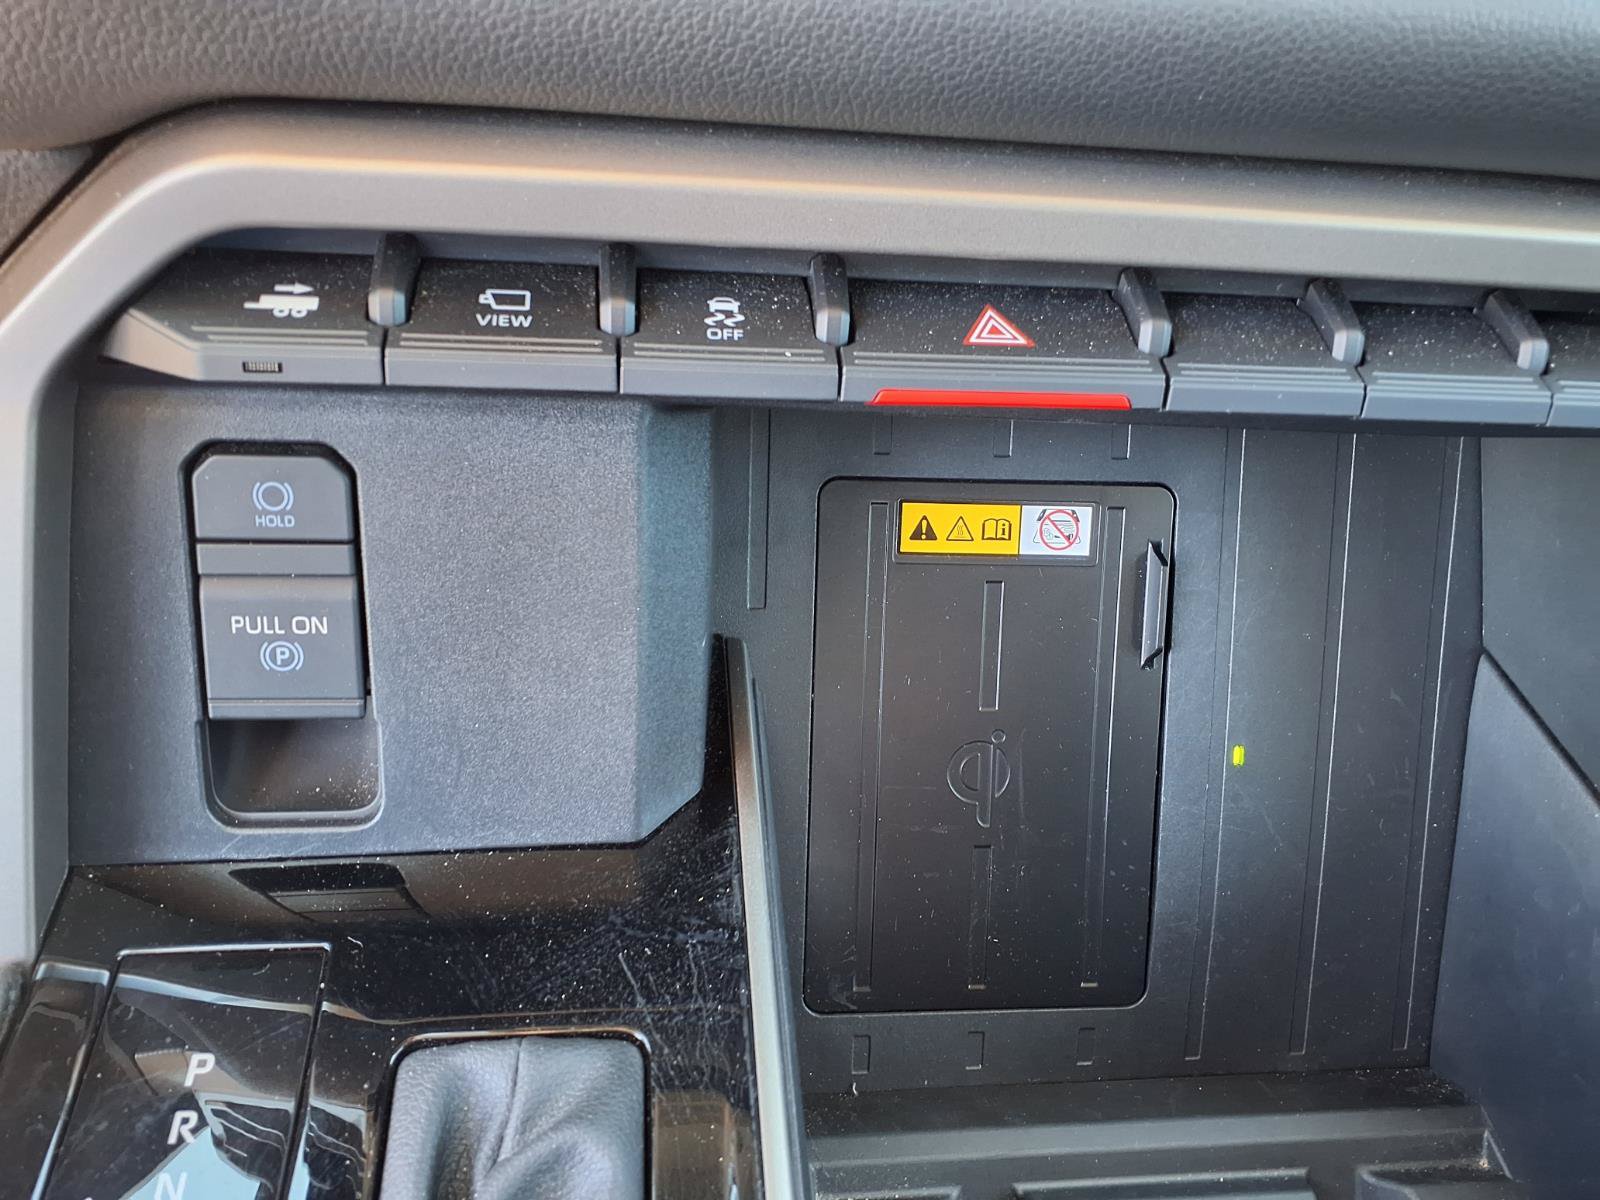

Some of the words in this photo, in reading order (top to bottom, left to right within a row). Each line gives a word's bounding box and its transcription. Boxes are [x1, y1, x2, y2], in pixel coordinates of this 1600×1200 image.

[475, 313, 533, 328] VIEW
[706, 328, 744, 341] OFF
[255, 514, 295, 527] HOLD
[230, 615, 285, 634] PULL
[291, 615, 328, 634] ON
[183, 1052, 216, 1087] P
[167, 1109, 199, 1145] R
[154, 1171, 188, 1200] N
